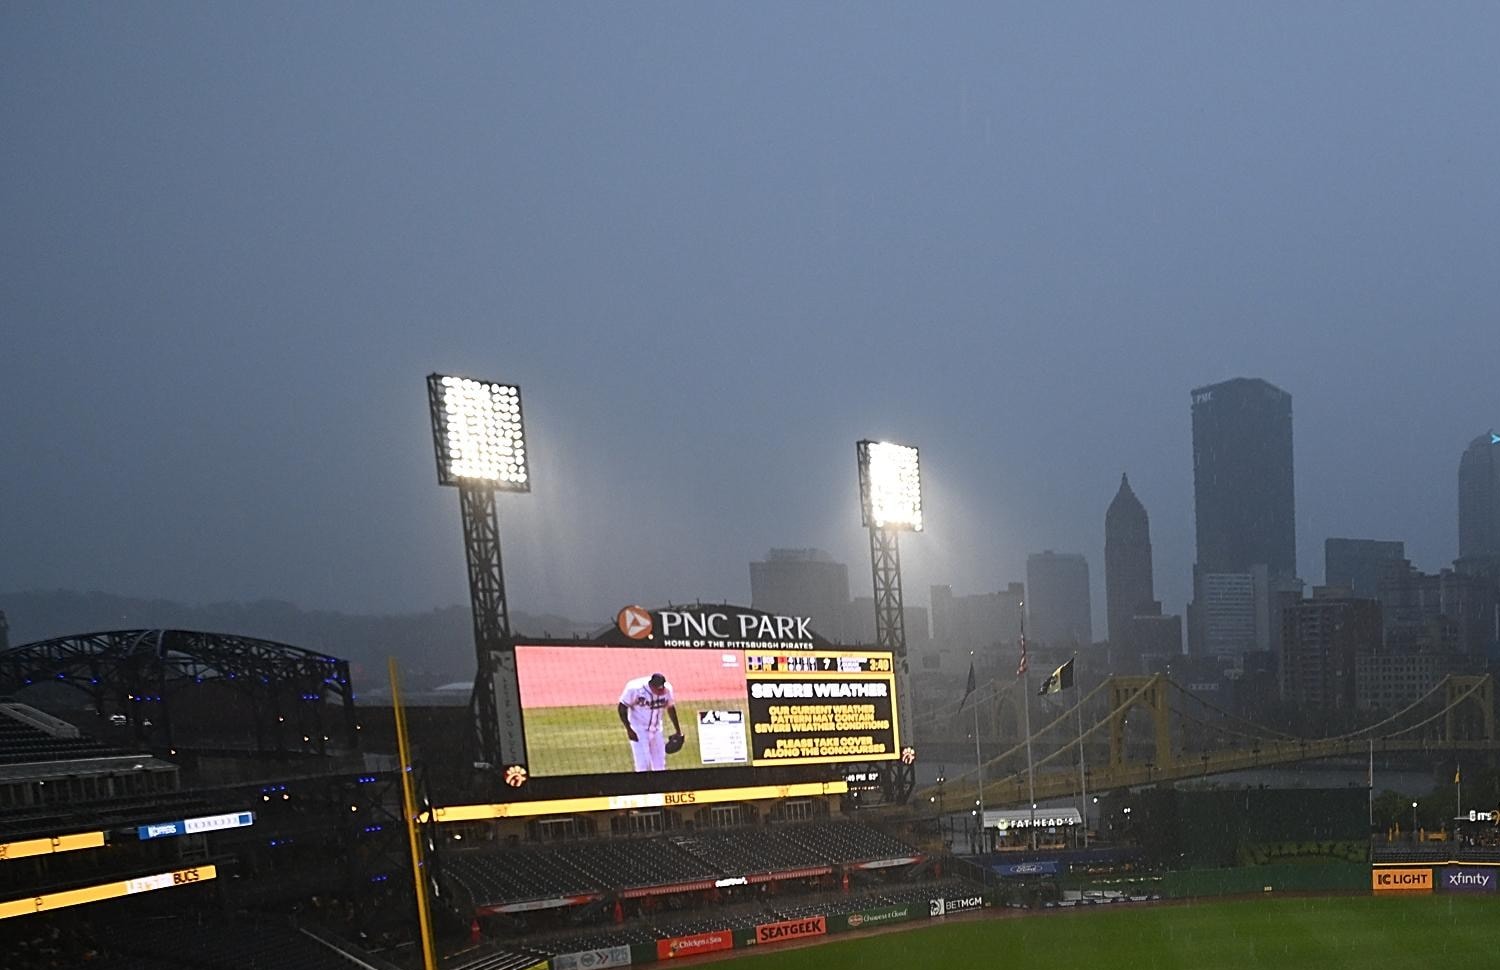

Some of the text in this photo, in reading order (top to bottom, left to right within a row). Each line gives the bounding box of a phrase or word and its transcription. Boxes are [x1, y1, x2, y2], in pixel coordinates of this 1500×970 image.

[659, 611, 813, 640] PNC PARK
[664, 640, 813, 649] HOME OF THE PITTSBURGH PIRATES
[751, 683, 888, 699] SEVERE WEATHER
[768, 704, 875, 715] OUR CURRENT WEATHER
[771, 713, 875, 724] PATTERN MAY CONTAIN
[754, 720, 889, 733] SEVERE WEATHER CONDITIONS
[776, 737, 873, 749] PLEASE TAKE COVER
[763, 744, 886, 758] ALONG THE CONCOURSES
[664, 793, 696, 804] BUCS
[1477, 811, 1492, 821] IT'S
[1011, 819, 1030, 828] FAT
[172, 869, 199, 885] BUCS
[1393, 873, 1428, 885] LIGHT
[1449, 872, 1490, 886] xfinity
[945, 897, 982, 911] BETMGM
[760, 919, 822, 941] SEATGEEK
[679, 938, 705, 949] Chicken
